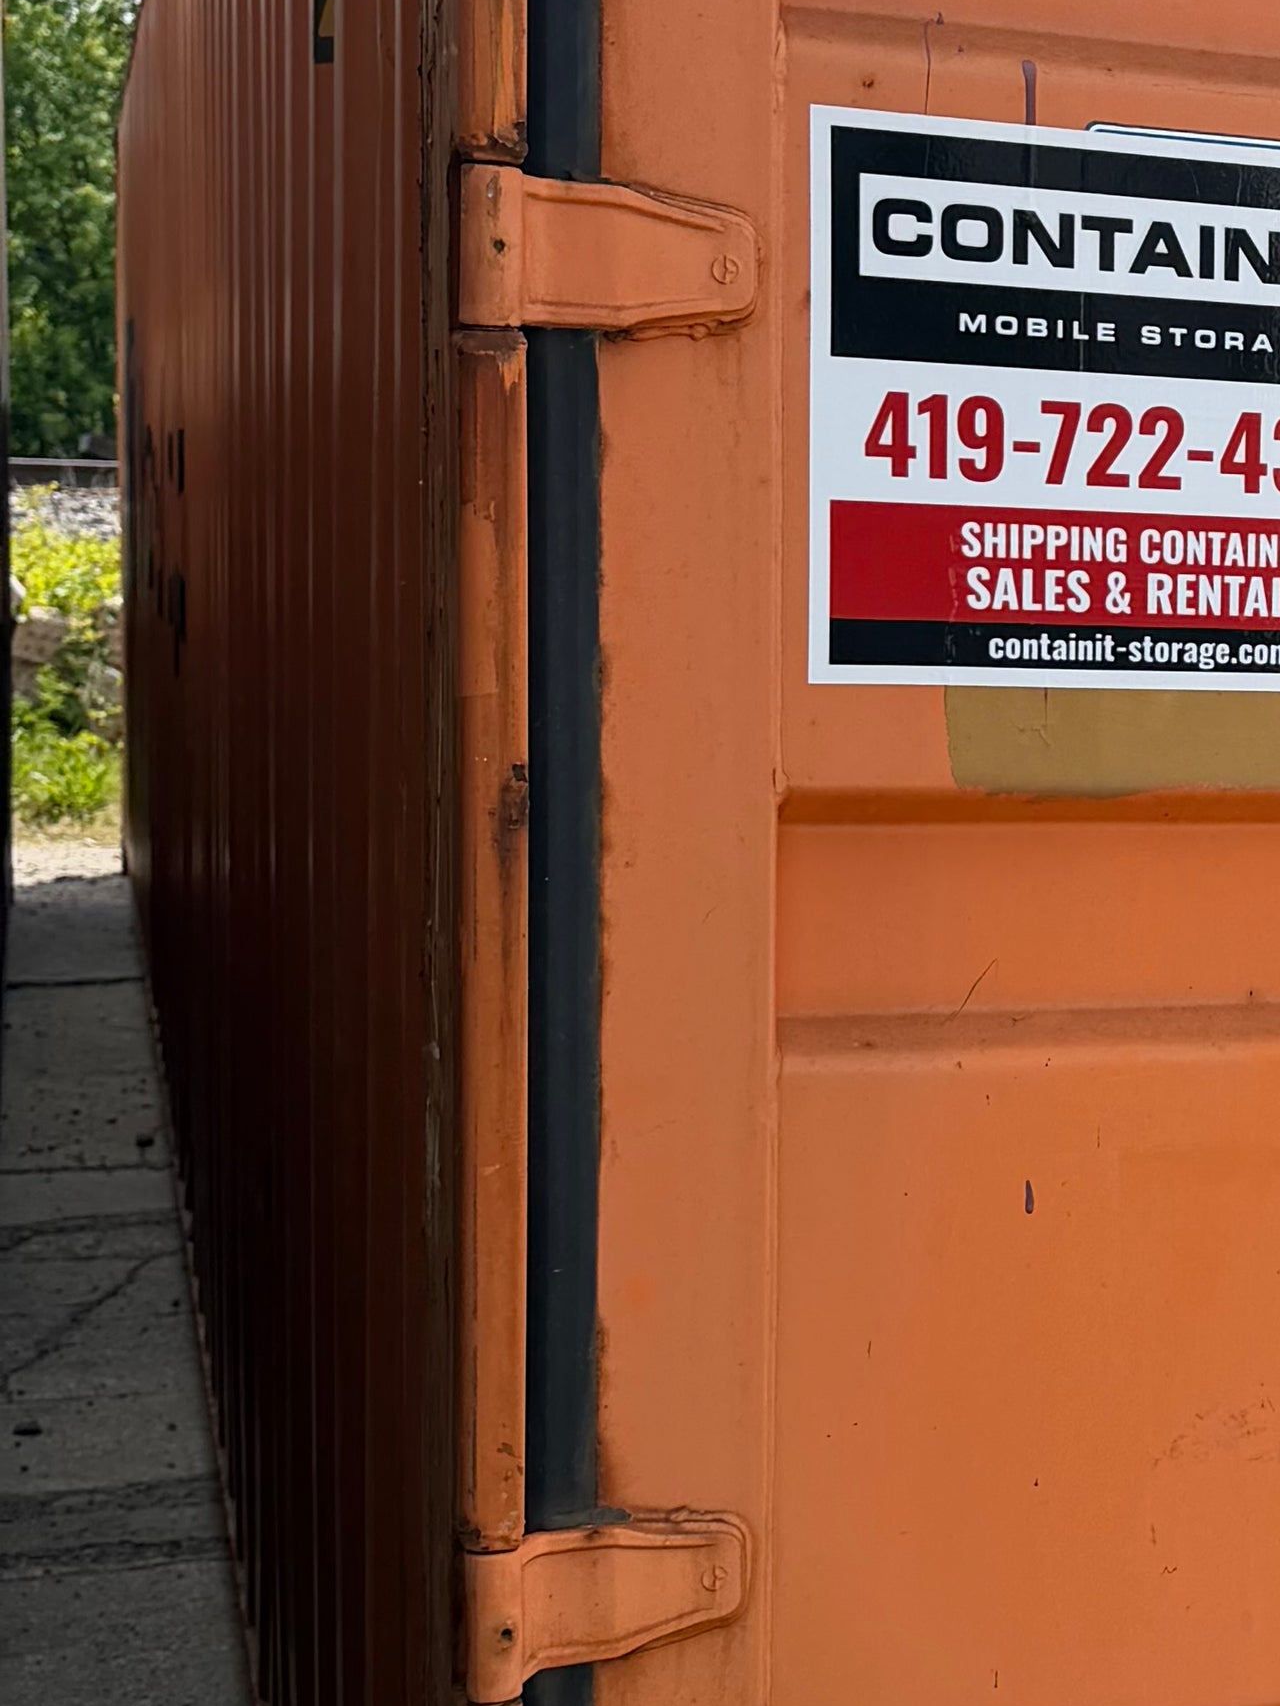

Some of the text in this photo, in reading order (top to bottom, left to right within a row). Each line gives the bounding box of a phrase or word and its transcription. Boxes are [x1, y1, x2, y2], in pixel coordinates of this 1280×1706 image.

[958, 313, 1117, 342] MOBILE
[961, 521, 1127, 563] SHIPPING
[965, 566, 1091, 614] SALES
[1104, 573, 1133, 616] &
